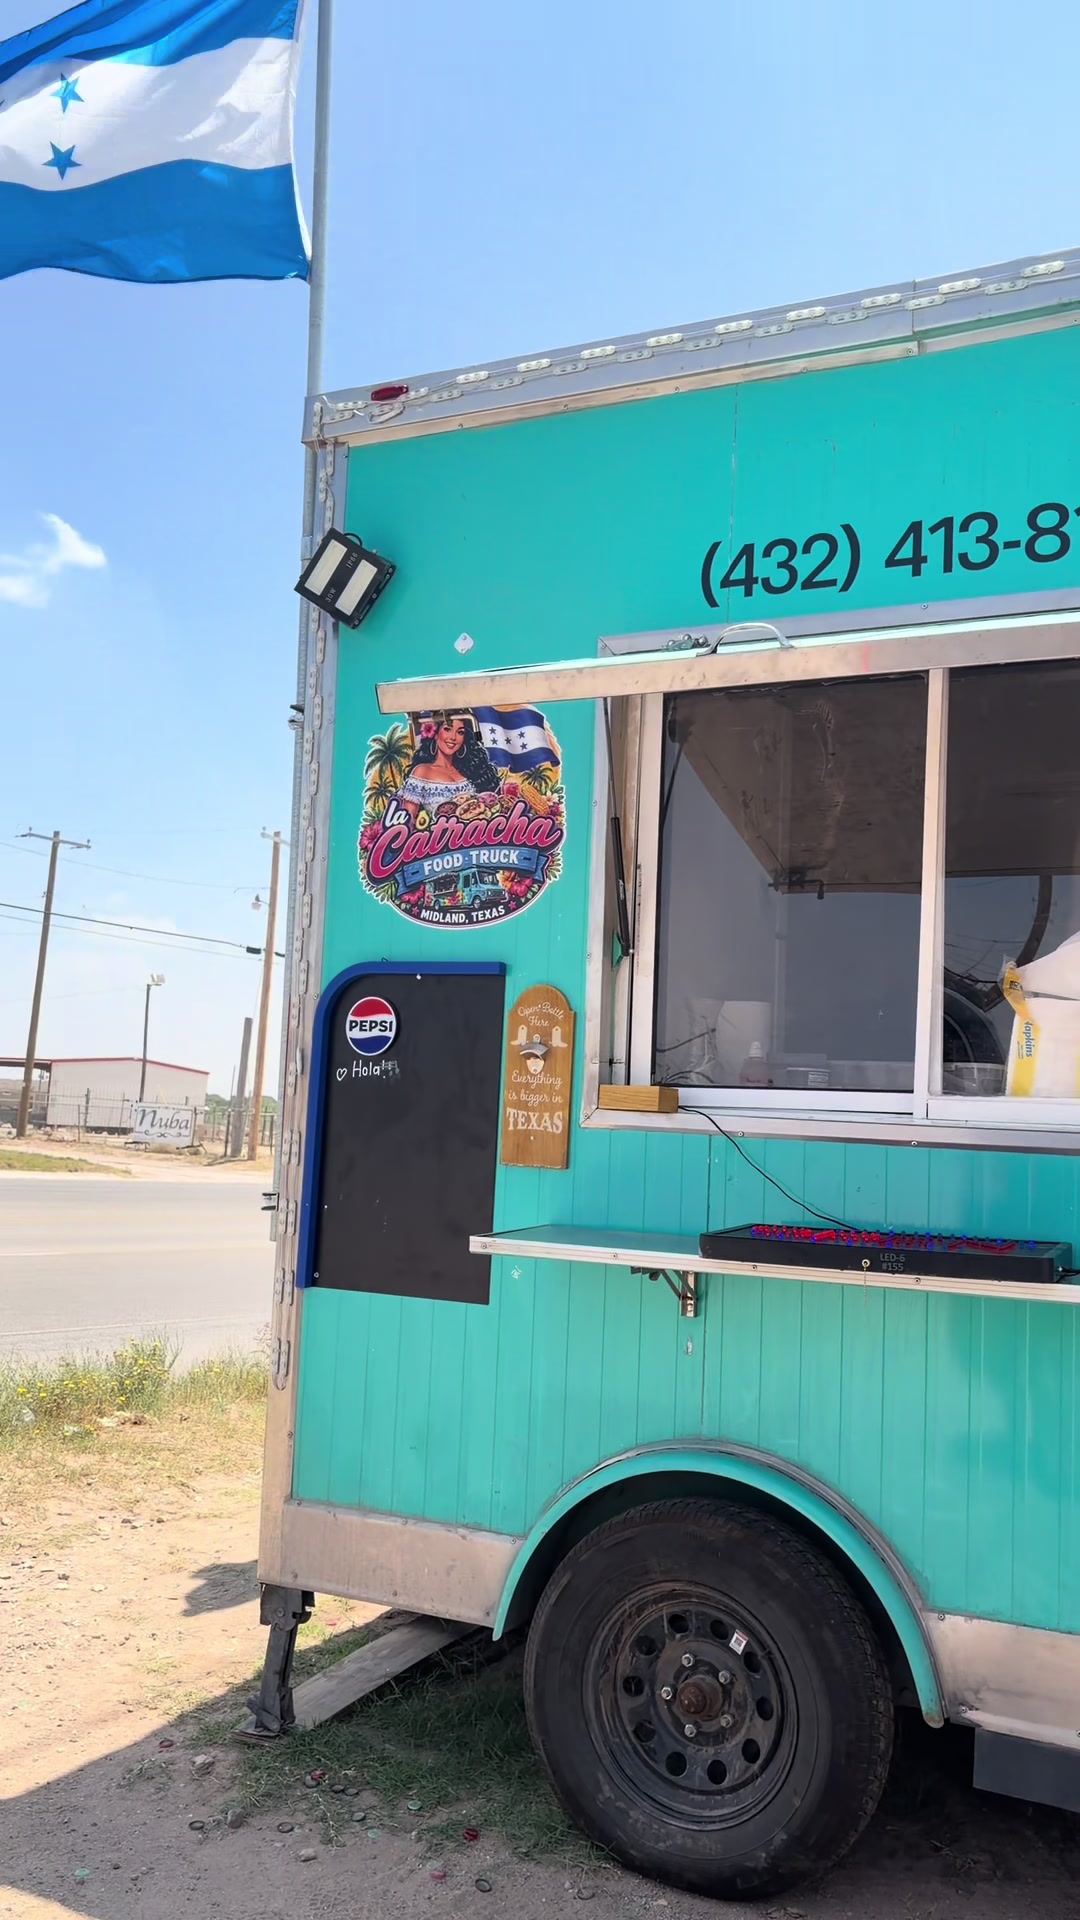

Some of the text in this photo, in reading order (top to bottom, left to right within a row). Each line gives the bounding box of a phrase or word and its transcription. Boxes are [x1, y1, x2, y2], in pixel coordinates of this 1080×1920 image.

[700, 502, 1080, 608] (432) 413-8
[369, 800, 561, 879] Catracha
[423, 849, 519, 876] FOOD TRUCK
[420, 908, 506, 924] MIDLAND, TEXAS
[541, 1001, 564, 1020] Bottle
[349, 1019, 393, 1033] PEPSI
[528, 1015, 550, 1027] Here
[511, 1069, 563, 1090] Everything
[508, 1088, 564, 1107] is bigger in
[506, 1107, 563, 1134] TEXAS
